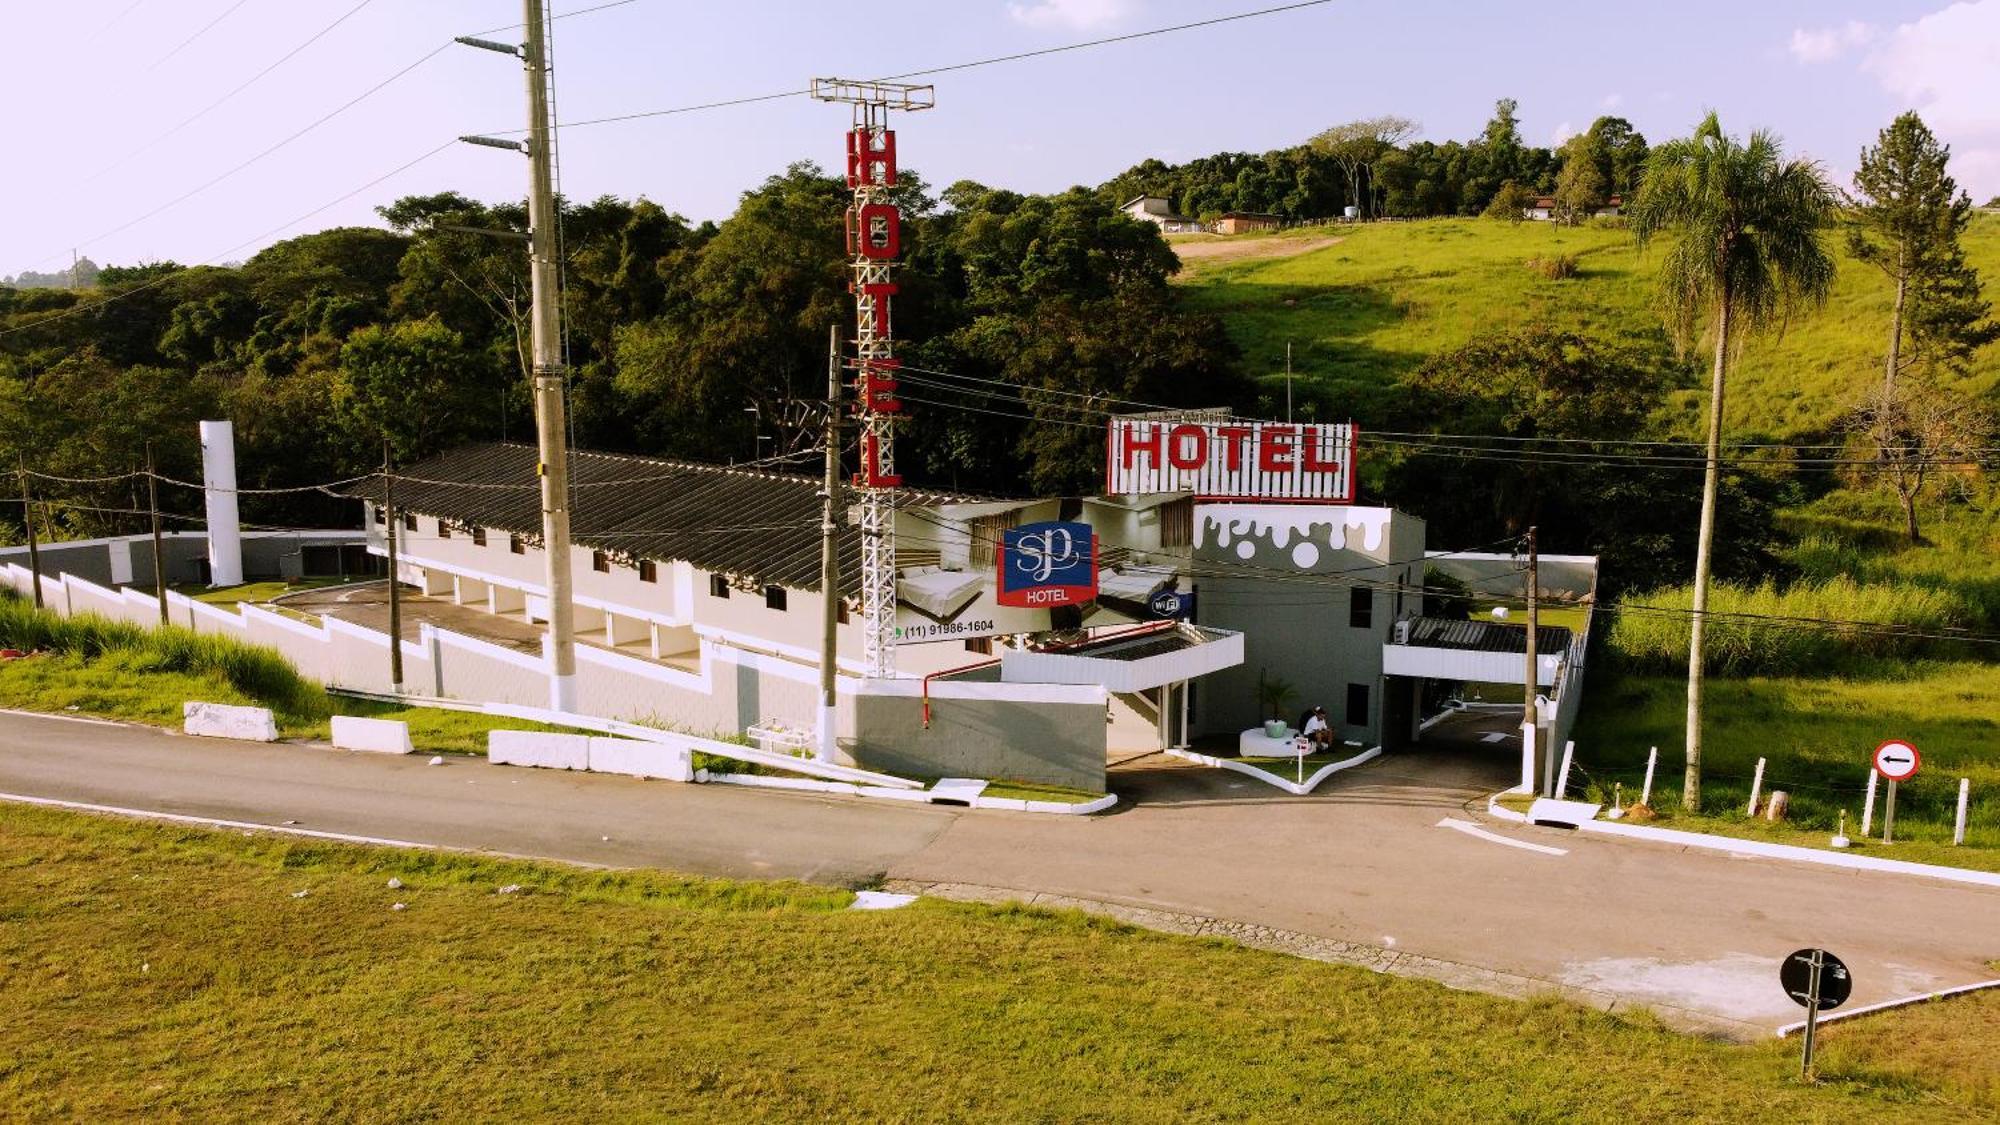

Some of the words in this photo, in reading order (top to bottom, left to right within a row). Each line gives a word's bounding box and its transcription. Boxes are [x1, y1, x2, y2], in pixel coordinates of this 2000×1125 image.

[859, 129, 904, 488] HOTEL
[1123, 422, 1340, 473] HOTEL
[1026, 588, 1070, 604] HOTEL
[905, 626, 926, 639] (11)
[929, 620, 994, 636] 91986-1604
